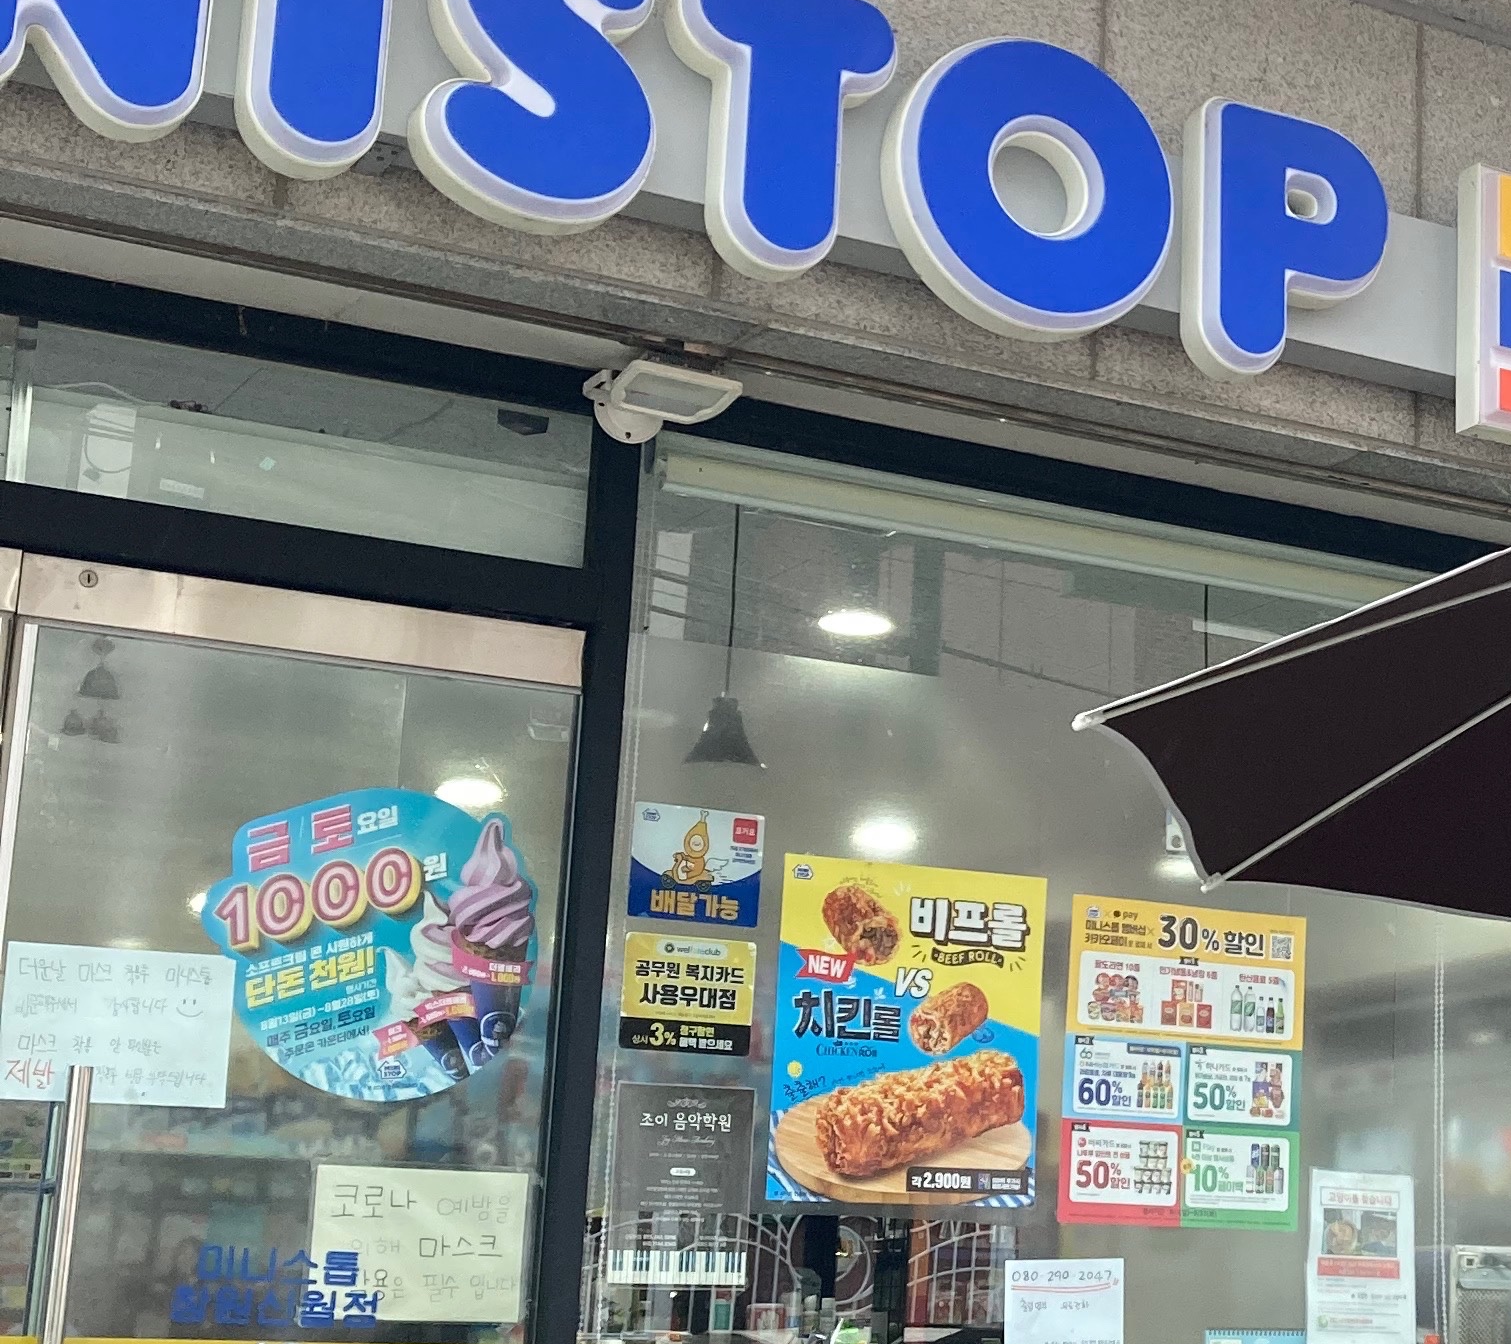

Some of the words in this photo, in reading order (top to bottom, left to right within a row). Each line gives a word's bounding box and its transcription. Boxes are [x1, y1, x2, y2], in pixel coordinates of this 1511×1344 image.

[909, 896, 1031, 952] 비프롤
[1122, 910, 1139, 922] pay
[1223, 930, 1265, 958] 할인
[807, 954, 847, 979] NEW
[936, 951, 965, 965] BEEF
[968, 951, 998, 965] ROLL
[79, 962, 112, 984] 마스크
[245, 965, 305, 1009] 단돈
[308, 945, 376, 992] 천원!
[635, 959, 680, 979] 공무원
[685, 963, 745, 984] 복지카드
[894, 966, 934, 999] VS
[639, 982, 737, 1011] 사용우대점
[266, 1032, 291, 1048] 매주
[337, 1005, 376, 1028] 토요일
[792, 988, 902, 1044] 치킨롤
[18, 1033, 58, 1056] 마스크
[4, 1058, 55, 1090] 제발
[1111, 1095, 1132, 1107] 할인
[1225, 1099, 1246, 1112] 할인
[639, 1112, 668, 1128] 조이
[672, 1112, 733, 1133] 음악학원
[911, 1175, 922, 1189] 각
[1110, 1177, 1131, 1190] 할인
[331, 1184, 418, 1218] 코로나
[436, 1193, 511, 1224] 예방을
[418, 1234, 504, 1258] 마스크
[198, 1244, 360, 1287] 미니스톱
[1011, 1269, 1113, 1283] 080-290-2047
[422, 1273, 461, 1303] 필수
[469, 1273, 517, 1300] 입니다
